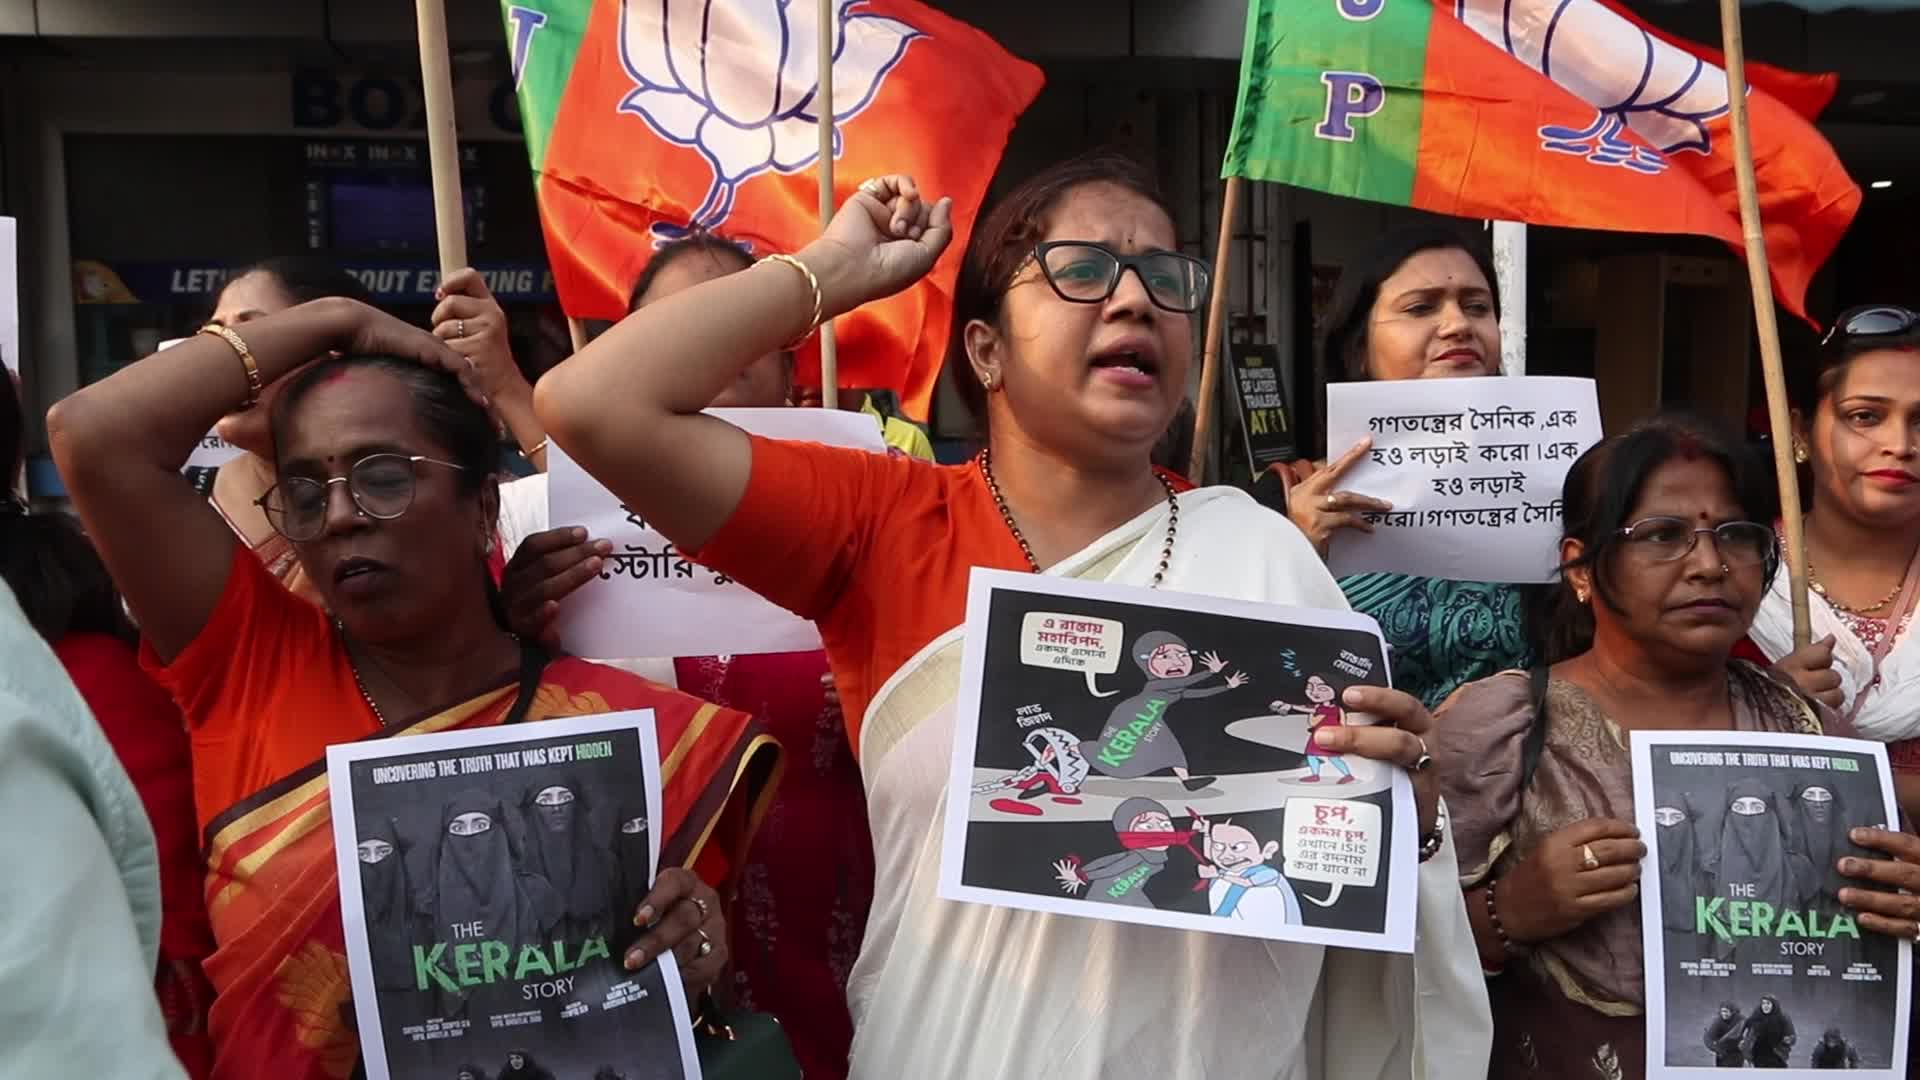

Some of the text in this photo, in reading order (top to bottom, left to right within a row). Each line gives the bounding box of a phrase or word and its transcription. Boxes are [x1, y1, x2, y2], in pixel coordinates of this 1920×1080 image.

[170, 268, 228, 294] LET'
[1251, 409, 1268, 434] AT
[1369, 413, 1463, 433] গণতন্ত্রের
[1468, 406, 1536, 431] সৈনিক
[1372, 447, 1402, 465] হও
[1408, 441, 1469, 468] লড়াই
[1478, 444, 1529, 462] করো
[1432, 471, 1526, 498] হও লড়াই
[1522, 500, 1563, 522] সৈনি
[1097, 698, 1168, 768] KERALA
[372, 740, 613, 785] UNCOVERING THE TRUTH THAT WAS KEPT HIDDEN
[1670, 751, 1724, 766] UNCOVERING
[1724, 752, 1741, 766] THE
[1742, 752, 1769, 767] TRUTH
[1769, 754, 1791, 768] THAT
[1792, 755, 1811, 769] WAS
[1811, 756, 1831, 770] KEPT
[1314, 805, 1354, 825] চুপ,
[1342, 843, 1367, 854] ISIS
[1729, 883, 1755, 897] THE
[451, 920, 484, 939] THE
[1696, 896, 1861, 944] KERALA
[1780, 941, 1825, 956] STORY
[413, 935, 611, 993] KERALA
[522, 976, 576, 1001] STORY
